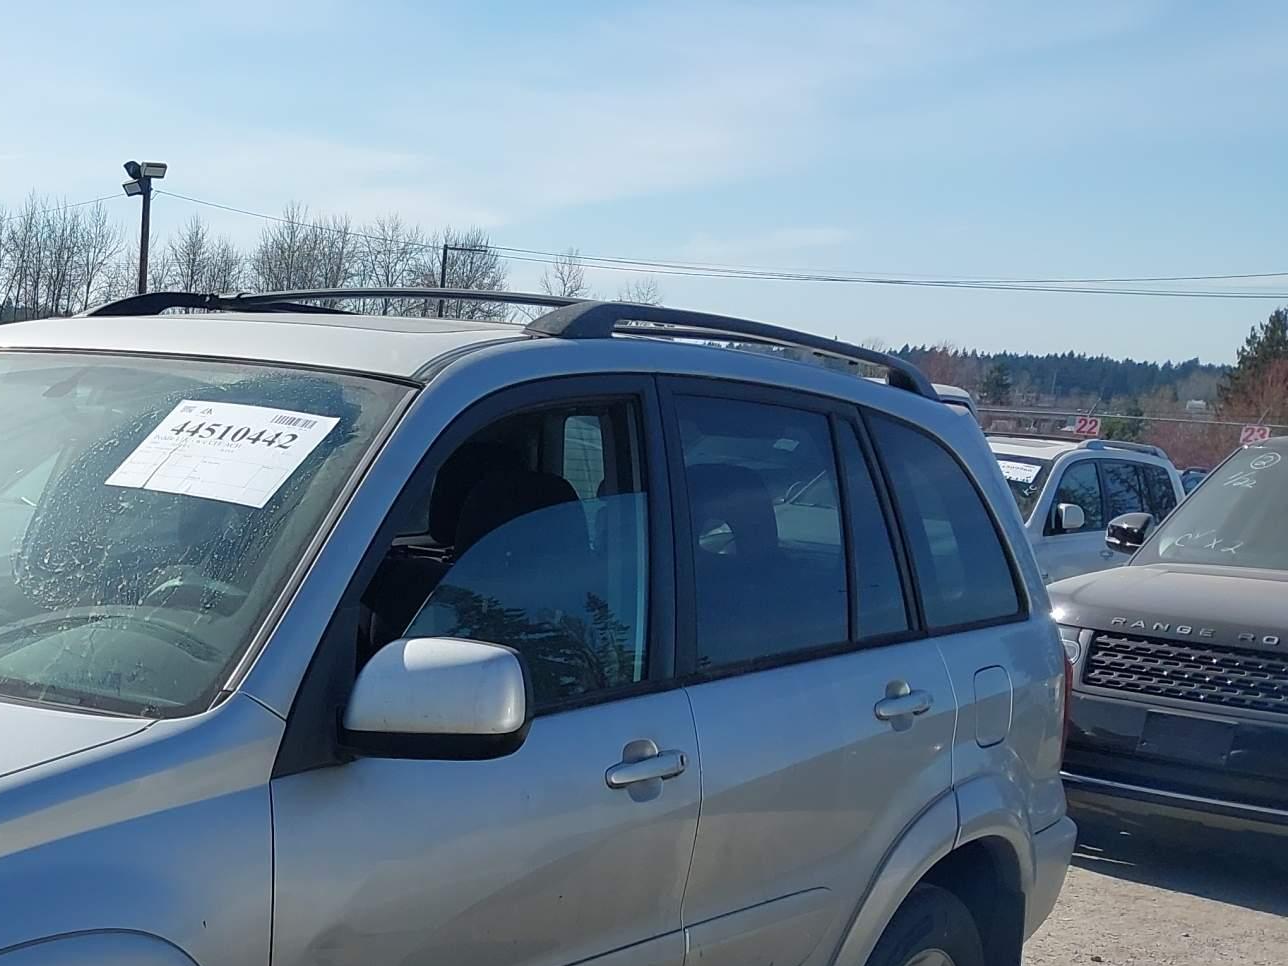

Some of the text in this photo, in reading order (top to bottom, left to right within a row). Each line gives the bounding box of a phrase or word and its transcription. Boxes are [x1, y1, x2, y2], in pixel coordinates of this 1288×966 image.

[171, 420, 299, 449] 44510442
[1076, 419, 1098, 434] 22
[1244, 427, 1267, 442] 23
[1111, 616, 1282, 646] RANGE RO
